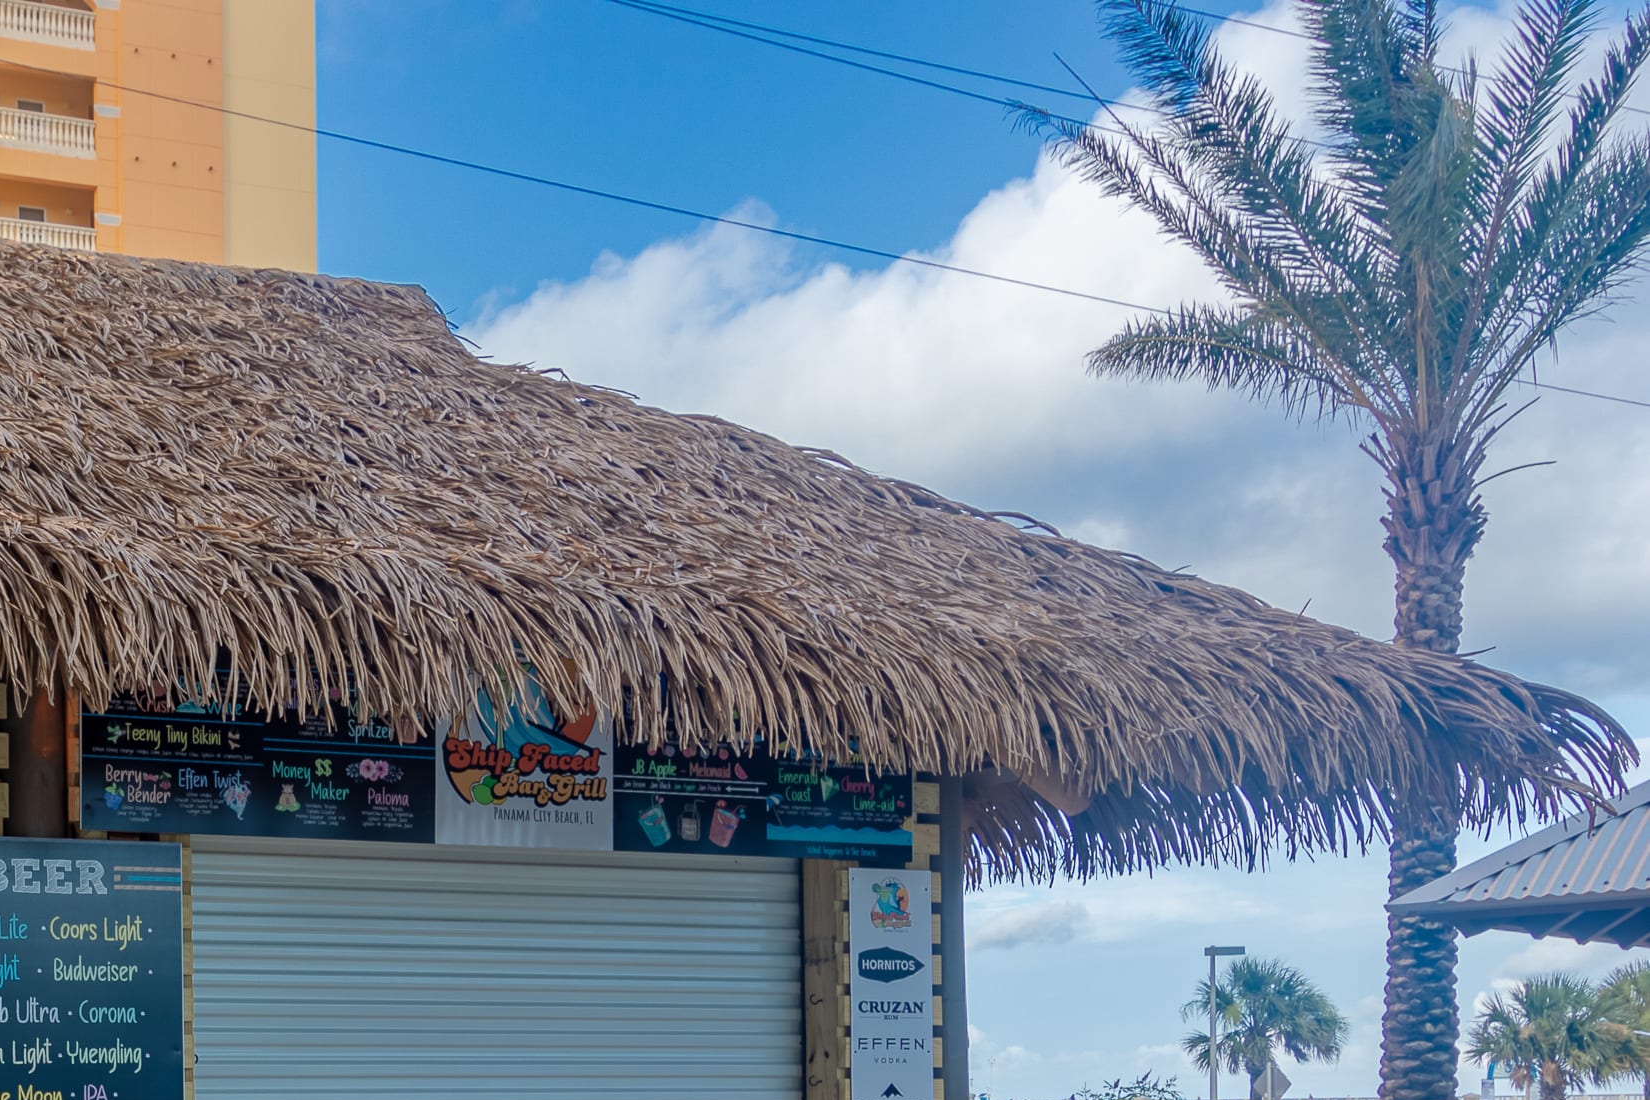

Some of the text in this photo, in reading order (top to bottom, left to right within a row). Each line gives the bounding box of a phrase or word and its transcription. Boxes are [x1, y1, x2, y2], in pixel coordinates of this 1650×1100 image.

[207, 700, 243, 717] We
[125, 722, 222, 752] Teeny Tiny Bikini
[445, 737, 600, 775] Ship Faced
[105, 764, 143, 789] Berry
[178, 767, 242, 790] Effen Twist
[272, 760, 311, 788] Money
[631, 758, 645, 775] JB
[648, 759, 677, 780] Apple
[778, 767, 819, 785] Emerald
[127, 784, 171, 804] Bender
[311, 781, 350, 801] Maker
[367, 786, 410, 807] Paloma
[493, 768, 607, 806] Bar & Grill
[785, 785, 812, 803] Coast
[840, 775, 875, 801] Cherry
[853, 794, 896, 812] Lime-aid
[493, 807, 530, 822] PANAMA
[533, 808, 551, 823] CITY
[586, 810, 594, 824] FL
[50, 916, 97, 941] Coors
[104, 915, 143, 951] Light
[53, 955, 138, 982] Budweiser
[862, 959, 916, 971] HORNITOS
[16, 996, 60, 1024] Ultra
[79, 1000, 138, 1024] Corona
[858, 1000, 924, 1014] CRUZAN
[858, 1037, 925, 1050] EFFEN
[12, 1037, 53, 1074] Light
[66, 1037, 142, 1074] Yuengling
